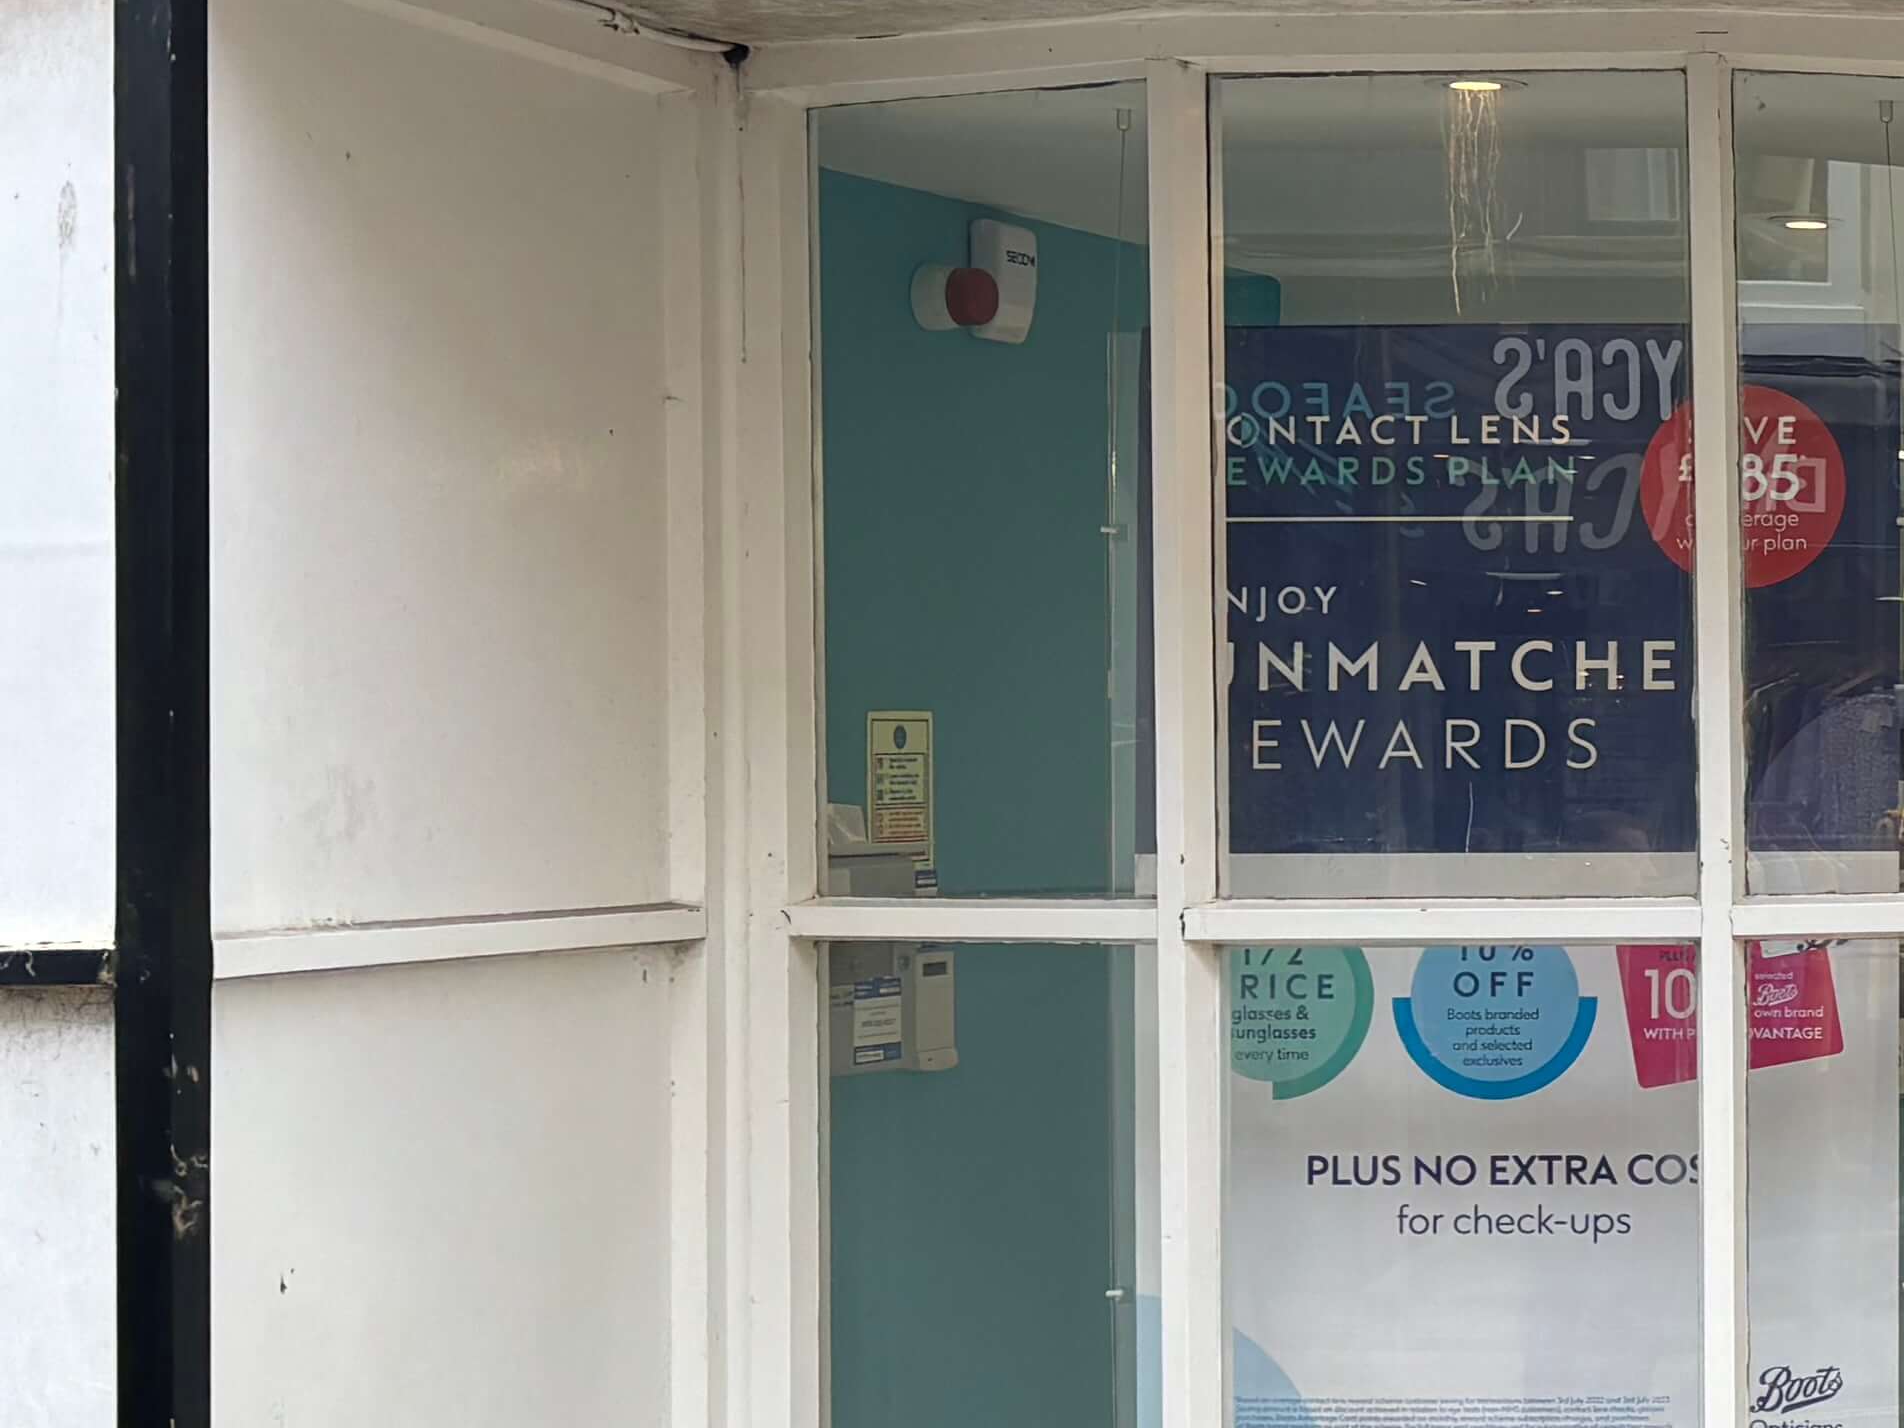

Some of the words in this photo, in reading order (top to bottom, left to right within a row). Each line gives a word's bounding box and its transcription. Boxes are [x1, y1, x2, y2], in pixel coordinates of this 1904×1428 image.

[1227, 414, 1429, 446] ONTACT
[1450, 414, 1573, 445] LENS
[1227, 455, 1426, 487] EWARDS
[1449, 455, 1577, 486] PLAN
[1763, 532, 1807, 556] plan
[1226, 585, 1338, 622] NJOY
[1227, 639, 1677, 692] NMATCHE
[1252, 717, 1599, 771] EWARDS
[1239, 974, 1335, 1000] RICE
[1453, 972, 1534, 998] OFF
[1753, 983, 1798, 1007] Boots
[1231, 1004, 1292, 1025] glasses
[1295, 1004, 1310, 1021] &
[1447, 1008, 1482, 1021] Boots
[1484, 1008, 1540, 1021] branded
[1754, 1009, 1782, 1019] own
[1783, 1005, 1824, 1018] brand
[1465, 1024, 1521, 1039] products
[1643, 1027, 1684, 1041] WITH
[1750, 1027, 1824, 1040] VANTAGE
[1234, 1050, 1274, 1064] every
[1277, 1047, 1310, 1061] time
[1453, 1039, 1478, 1052] and
[1480, 1039, 1533, 1052] selected
[1463, 1055, 1524, 1068] exclusives
[1306, 1154, 1402, 1186] PLUS
[1414, 1154, 1478, 1186] NO
[1489, 1154, 1618, 1186] EXTRA
[1627, 1153, 1700, 1186] COS
[1397, 1203, 1444, 1237] for
[1452, 1203, 1632, 1243] check-ups
[1749, 1365, 1844, 1415] Boots
